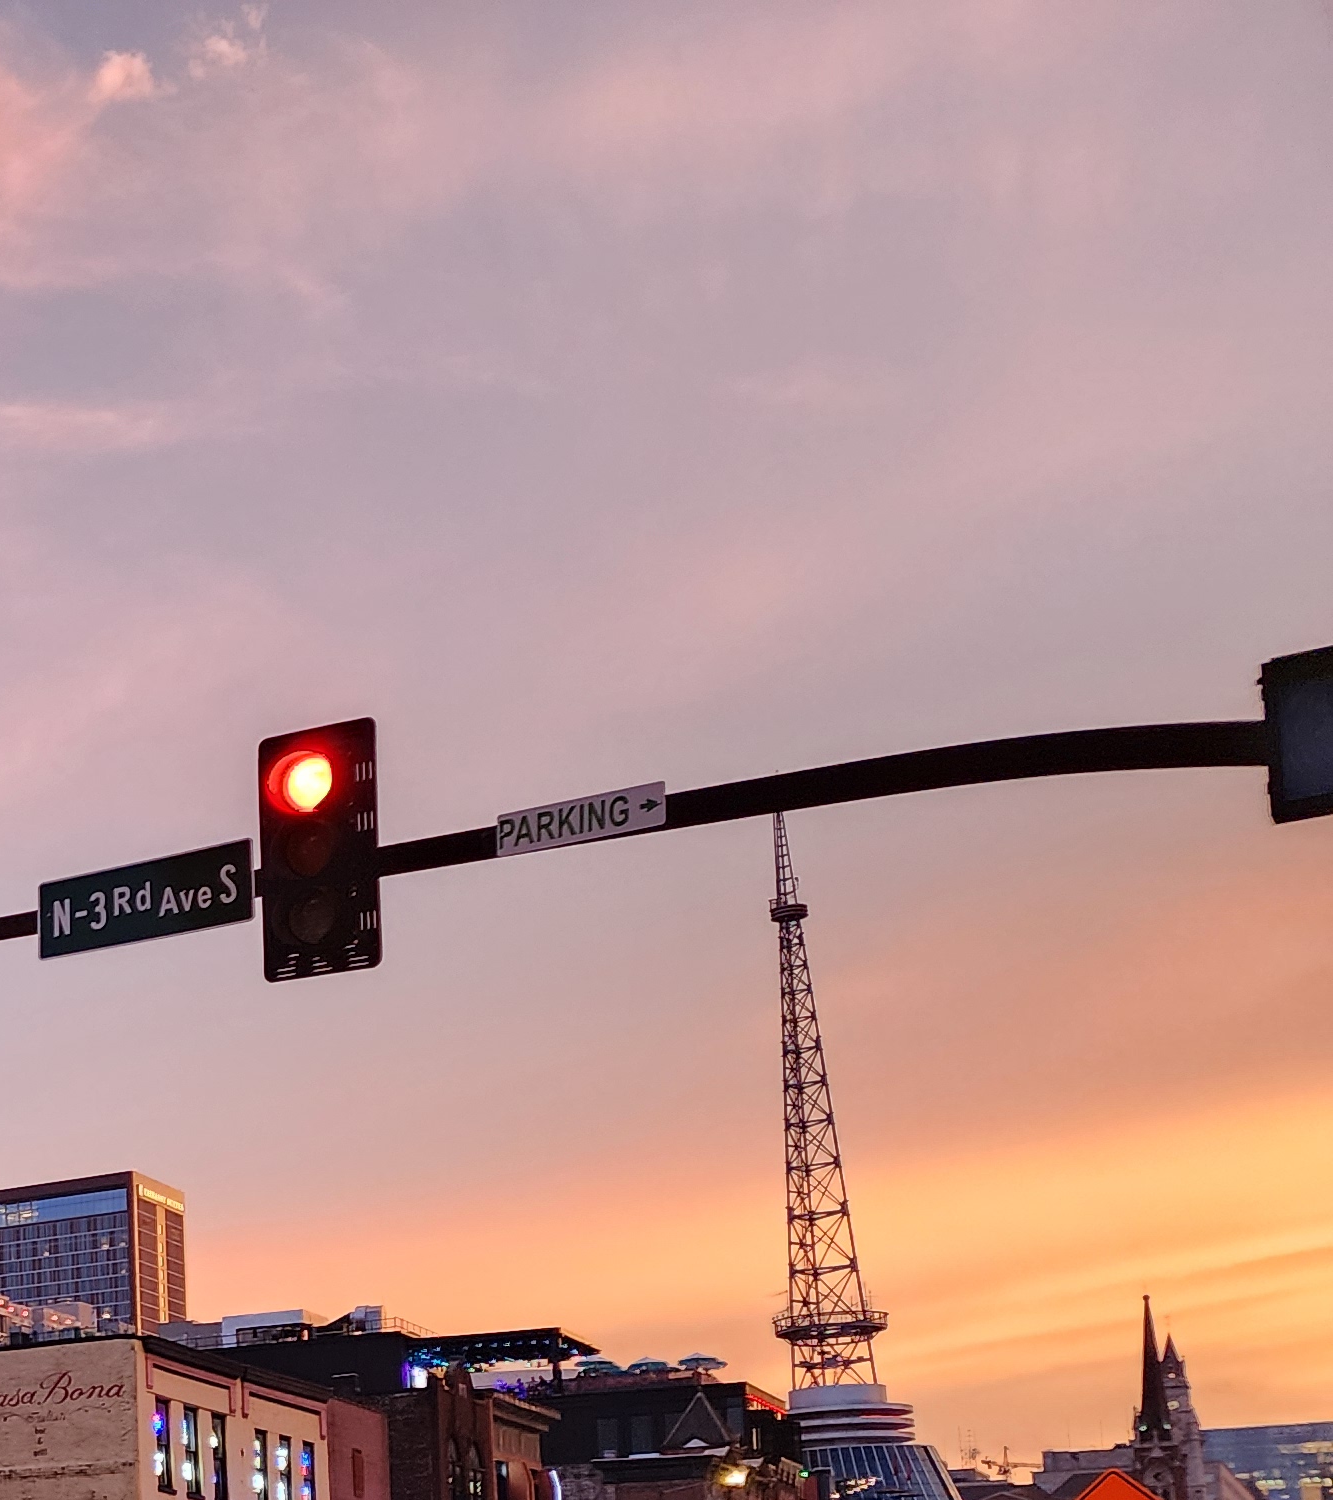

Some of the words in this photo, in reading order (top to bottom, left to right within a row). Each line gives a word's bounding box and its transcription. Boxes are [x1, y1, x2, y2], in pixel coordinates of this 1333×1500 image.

[499, 795, 630, 850] PARKING
[53, 881, 152, 938] N-3Rd
[158, 886, 213, 918] Ave
[219, 864, 238, 904] S
[35, 1370, 126, 1406] Bona
